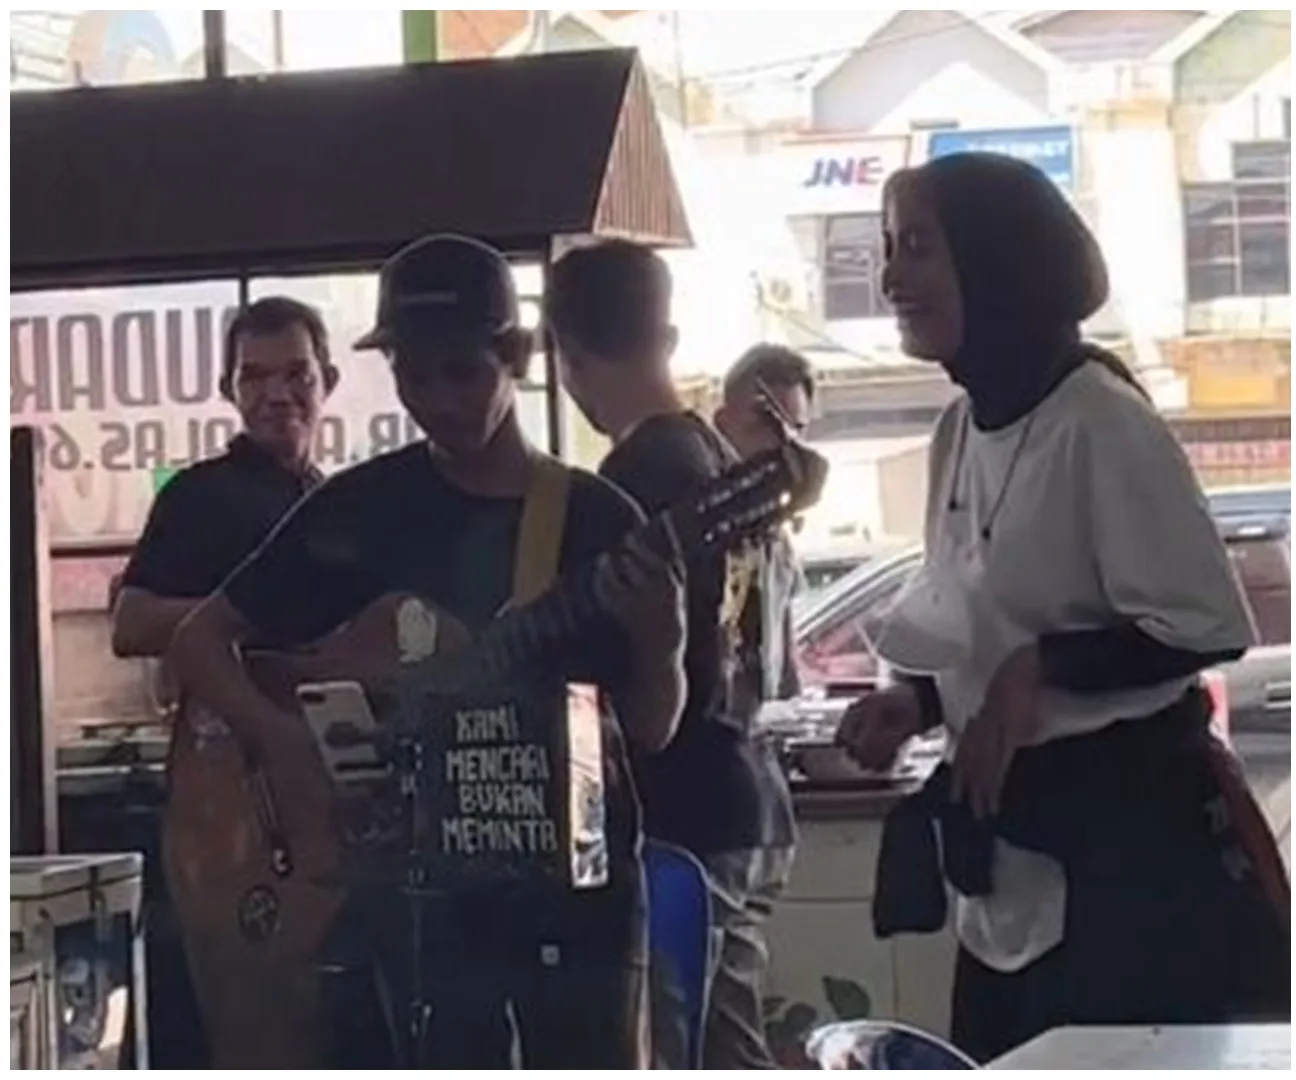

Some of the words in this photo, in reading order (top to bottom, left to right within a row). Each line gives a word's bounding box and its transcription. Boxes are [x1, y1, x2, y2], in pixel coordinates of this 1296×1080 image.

[803, 156, 884, 188] JNE
[456, 705, 519, 742] KAMI
[446, 744, 550, 781] MENCARI
[460, 783, 545, 817] BUKAN
[440, 817, 559, 854] MEMINTA
